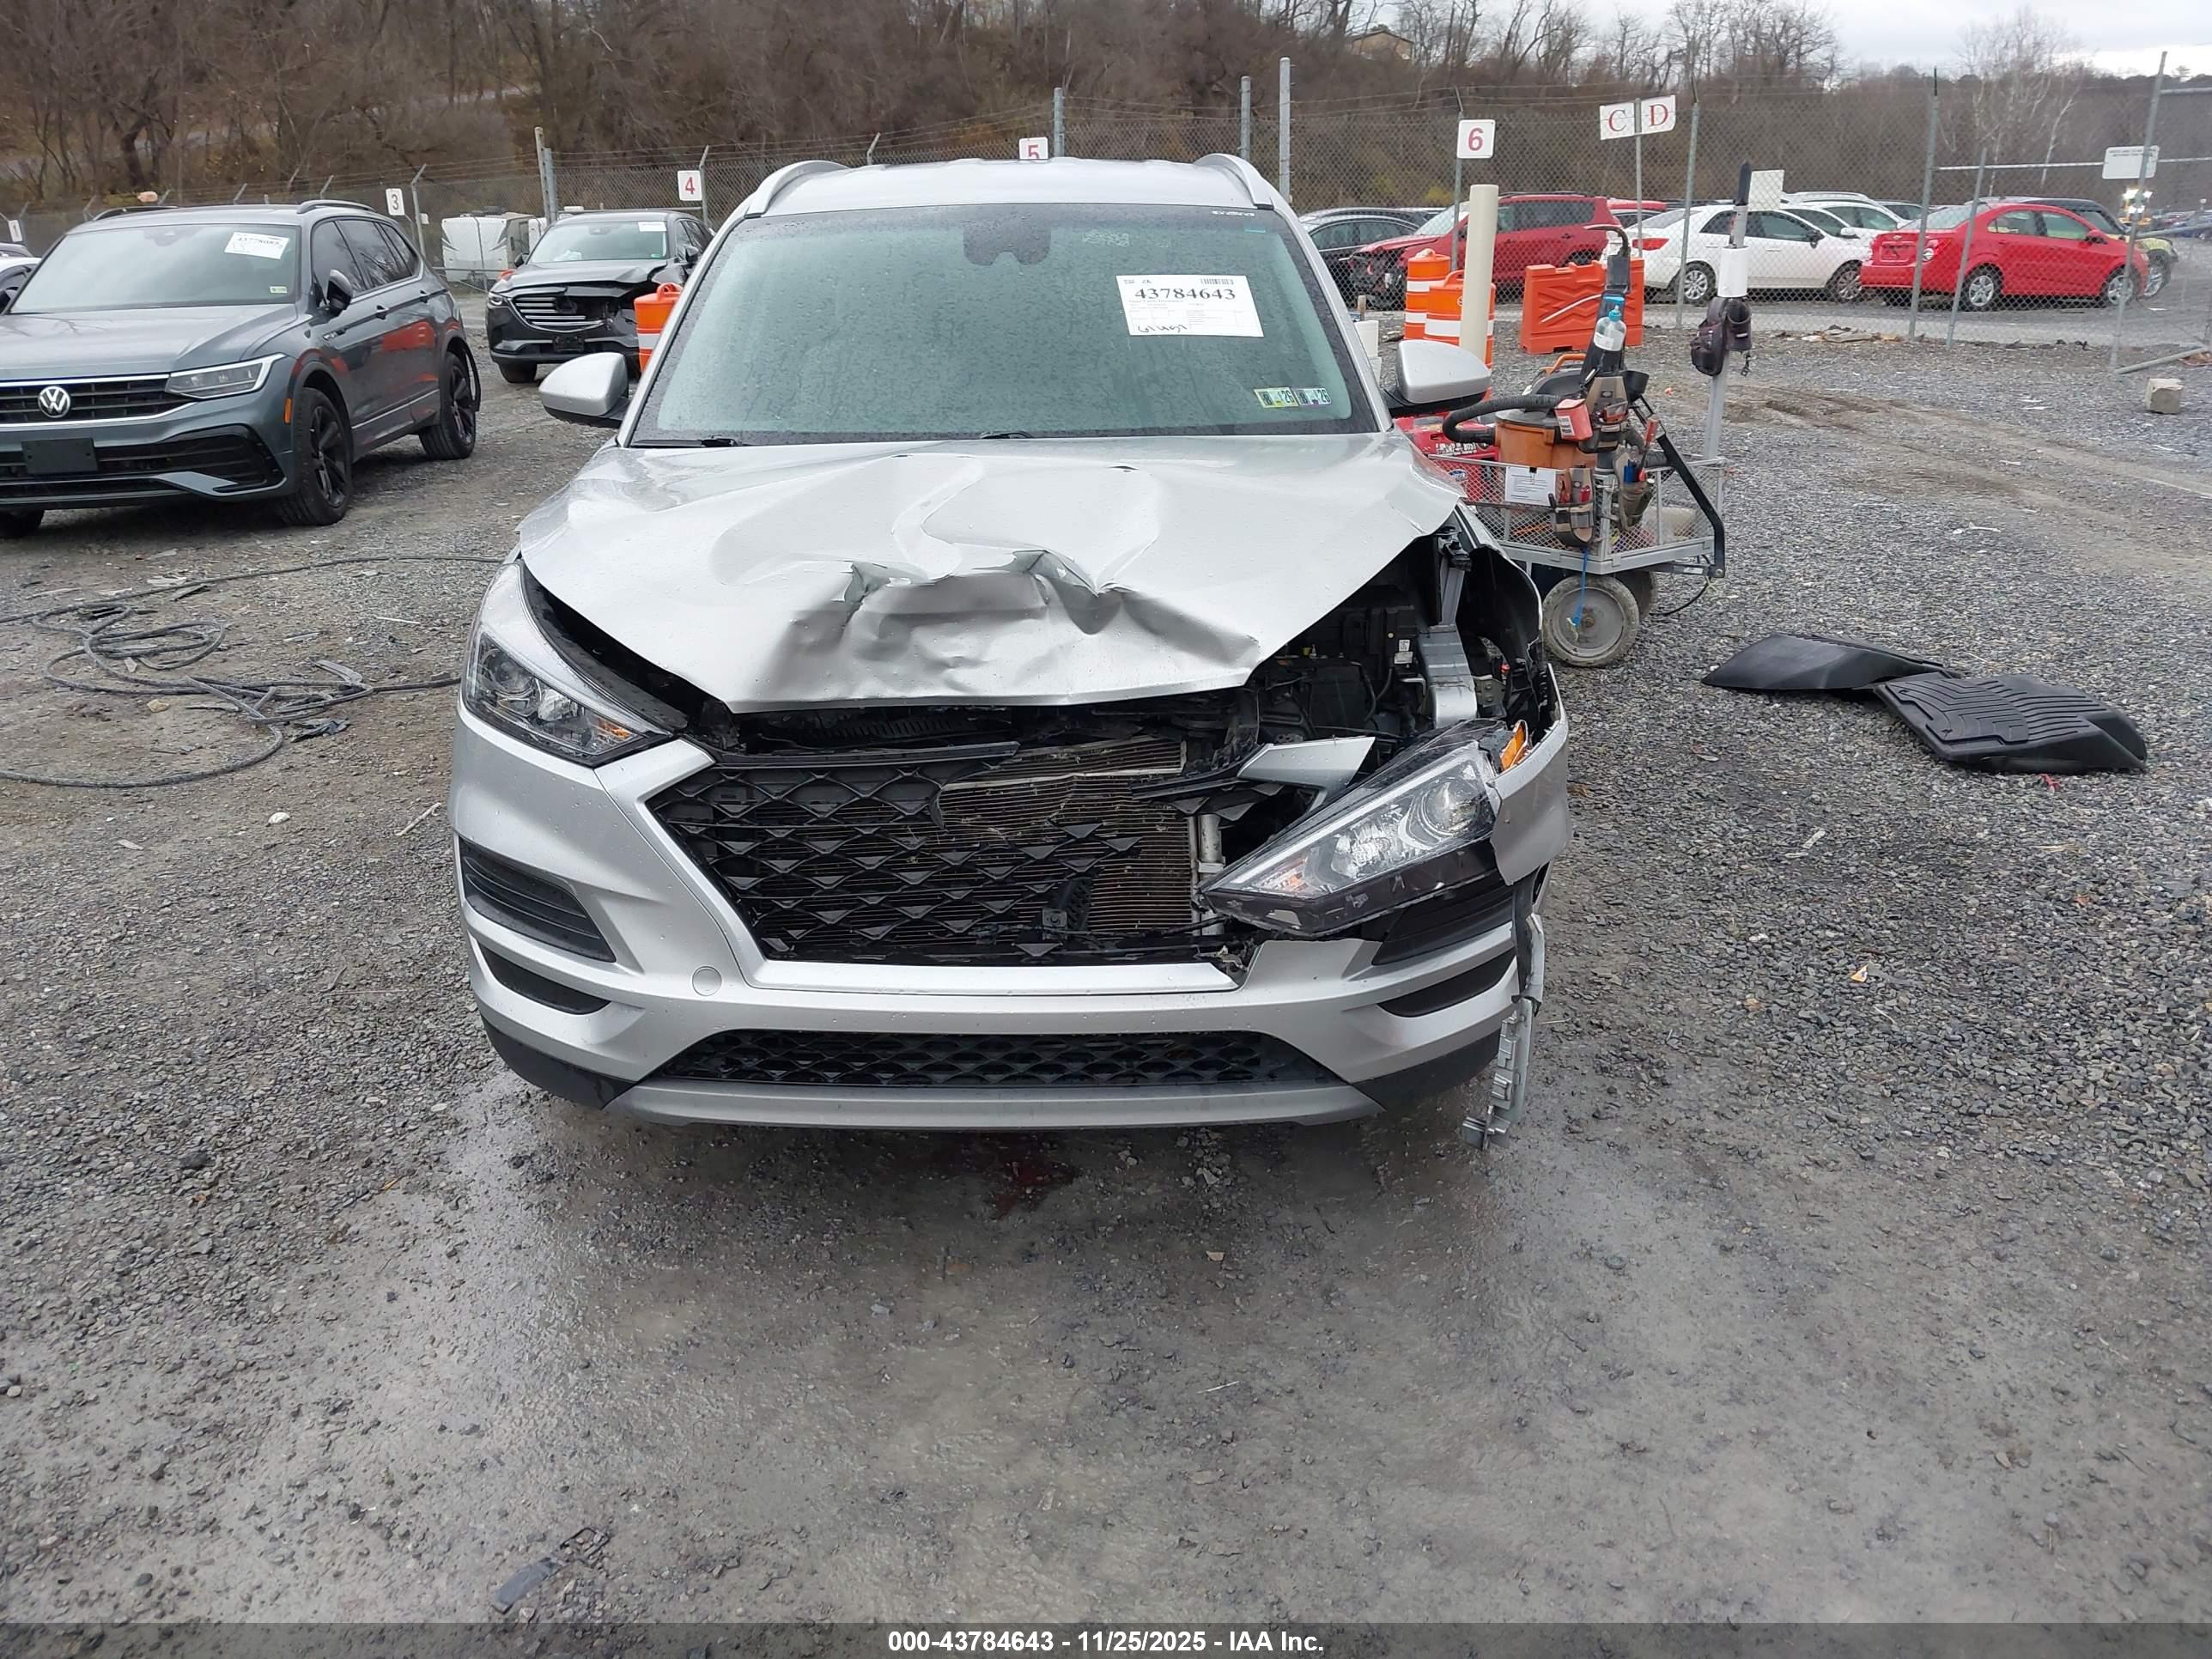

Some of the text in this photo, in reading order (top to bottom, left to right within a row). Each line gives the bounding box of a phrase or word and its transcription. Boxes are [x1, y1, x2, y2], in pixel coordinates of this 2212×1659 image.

[1608, 109, 1626, 131] C
[1649, 104, 1668, 126] D
[1468, 127, 1484, 151] 6
[1028, 144, 1040, 159] 5
[685, 176, 696, 195] 4
[392, 194, 399, 210] 3
[1134, 288, 1236, 301] 43784643
